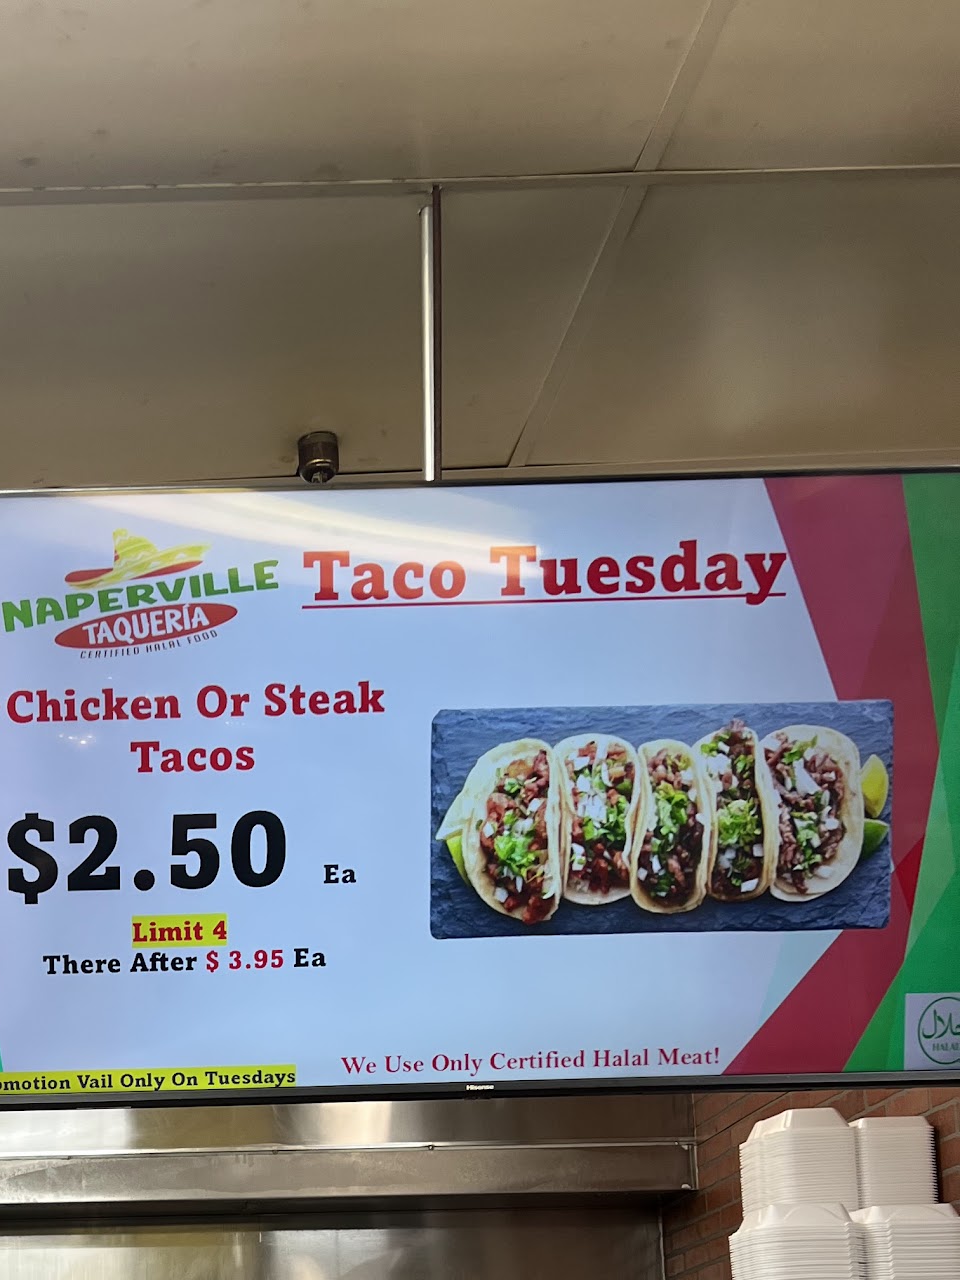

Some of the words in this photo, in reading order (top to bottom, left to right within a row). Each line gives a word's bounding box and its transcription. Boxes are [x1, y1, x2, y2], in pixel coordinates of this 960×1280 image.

[302, 550, 467, 601] Taco
[489, 539, 787, 605] Tuesday
[1, 559, 279, 633] NAPERVILLE
[82, 603, 210, 645] TAQUERÍA
[80, 645, 140, 659] CERTIFIED
[145, 640, 181, 654] HALAL
[187, 629, 219, 645] FOOD
[6, 688, 181, 724] Chicken
[196, 684, 250, 717] Or
[263, 681, 385, 717] Steak
[130, 740, 255, 773] Tacos
[7, 810, 287, 905] $2.50
[323, 863, 357, 885] Ea
[132, 920, 204, 943] Limit
[212, 920, 228, 941] 4
[42, 955, 122, 976] There
[130, 951, 198, 973] After
[293, 947, 327, 969] Ea
[341, 1055, 377, 1075] We
[384, 1054, 425, 1074] Use
[431, 1052, 484, 1077] Only
[490, 1048, 586, 1071] Certified
[592, 1047, 649, 1069] Halal
[657, 1046, 720, 1066] Meat!
[76, 1073, 113, 1090] Vail
[120, 1073, 166, 1092] Only
[171, 1072, 199, 1087] On
[205, 1070, 296, 1090] Tuesdays
